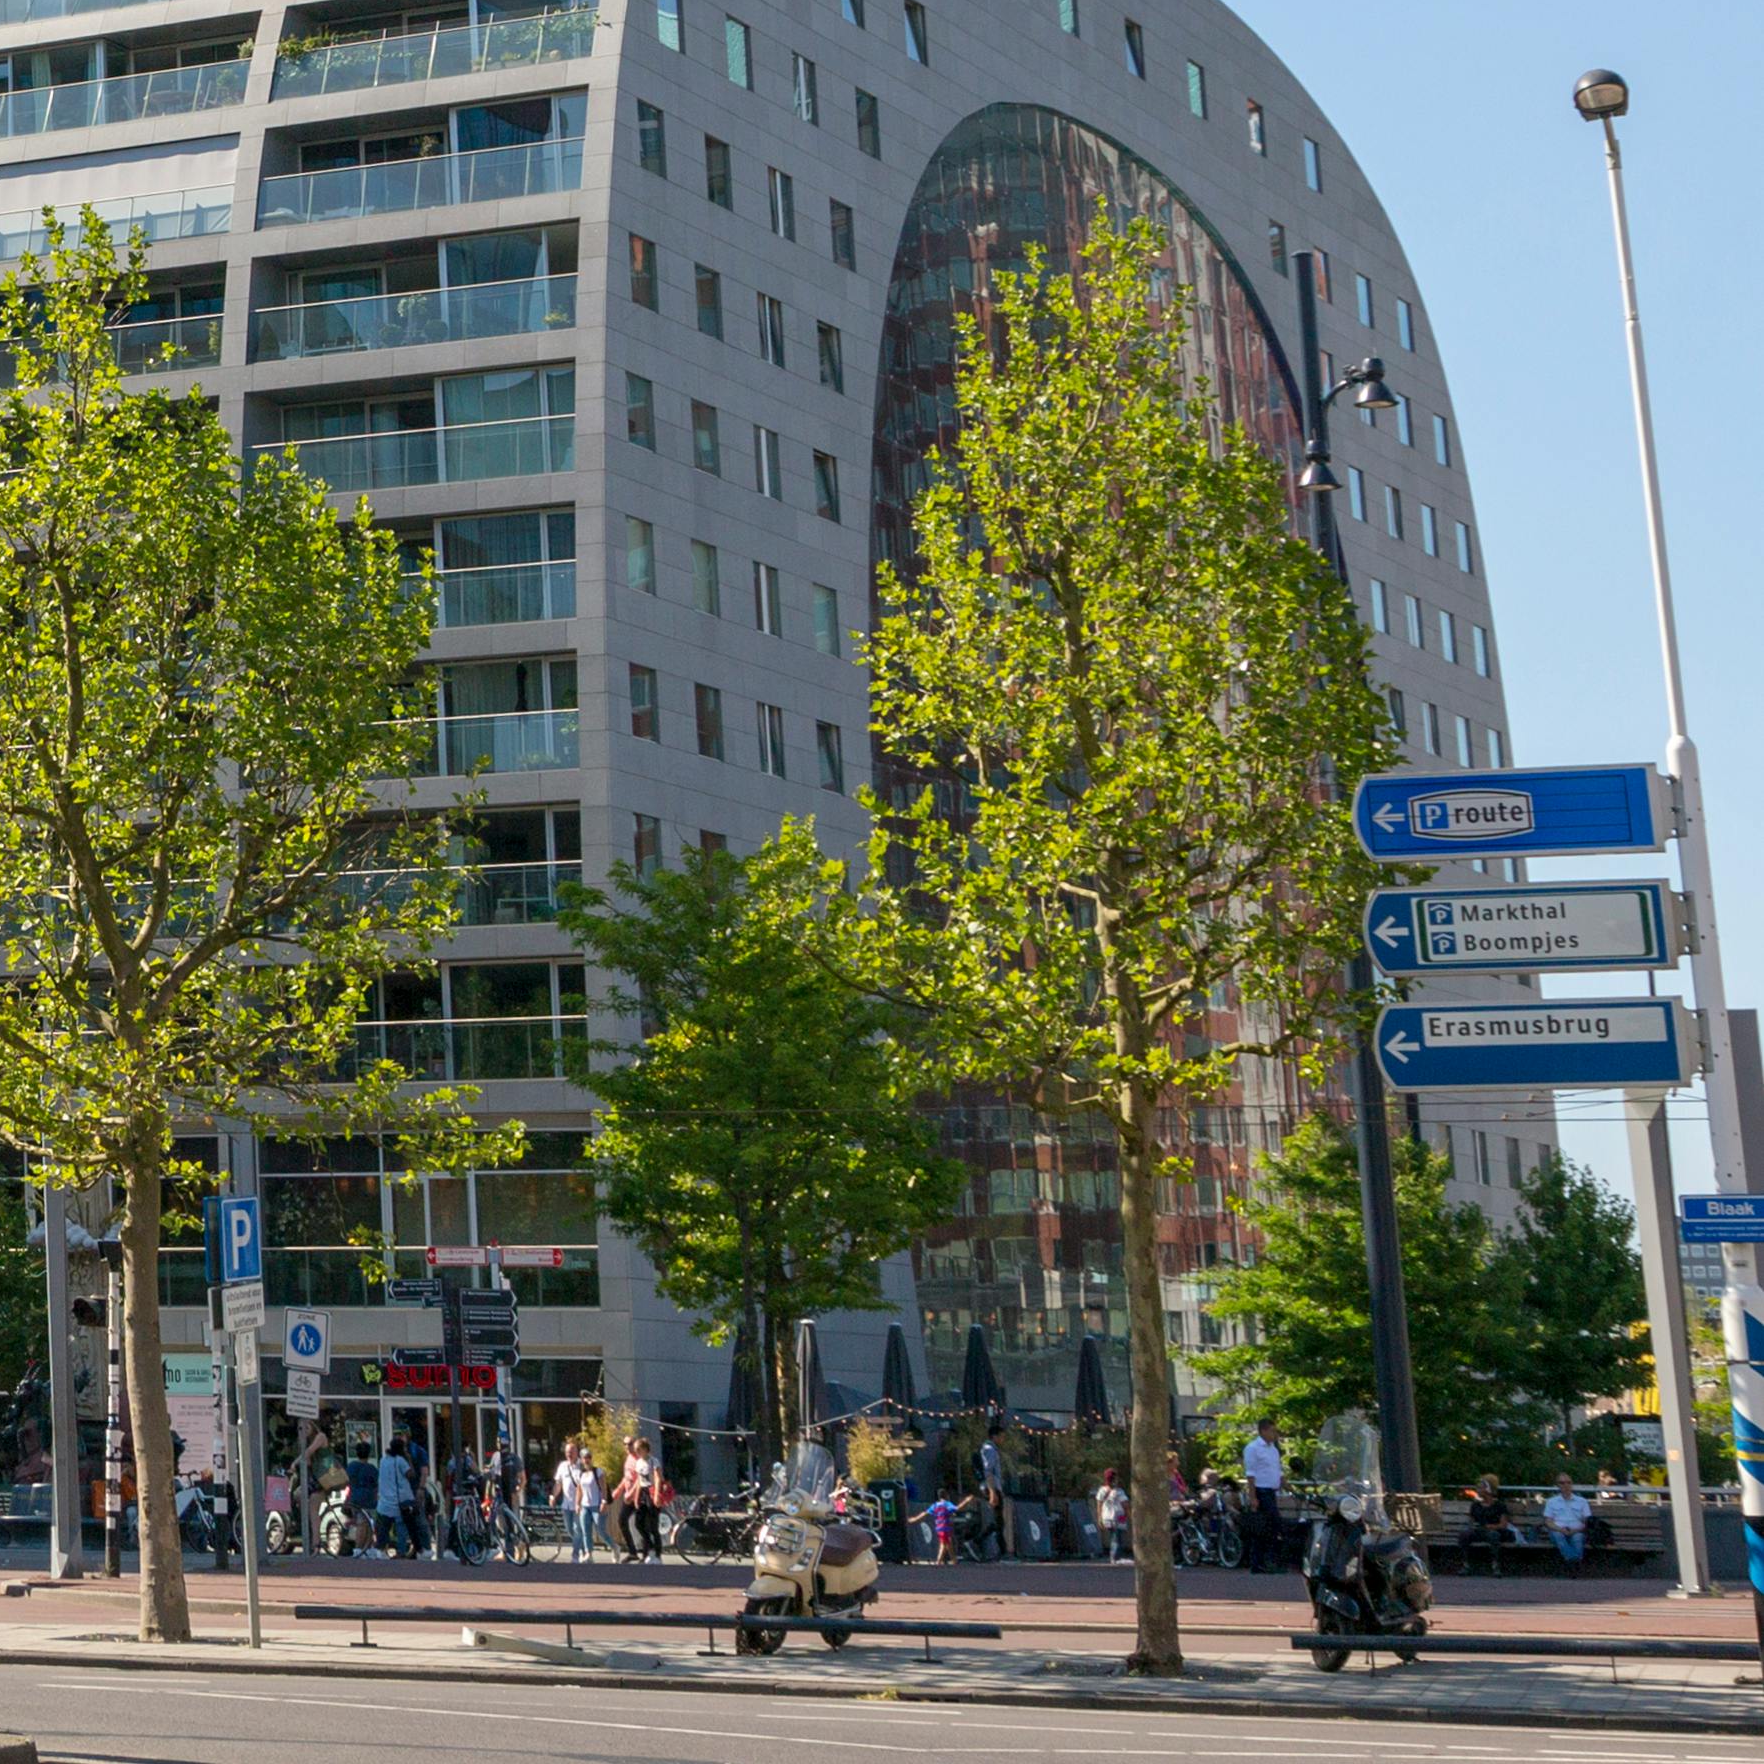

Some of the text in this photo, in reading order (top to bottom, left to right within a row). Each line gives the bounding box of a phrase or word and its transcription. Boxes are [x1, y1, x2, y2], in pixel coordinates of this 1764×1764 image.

[1454, 802, 1524, 824] route
[1461, 902, 1567, 922] Markthal
[1464, 932, 1580, 954] Boompjes
[1428, 1014, 1610, 1038] Erasmusbrug
[1706, 1201, 1756, 1216] Blaak
[230, 1208, 252, 1272] P
